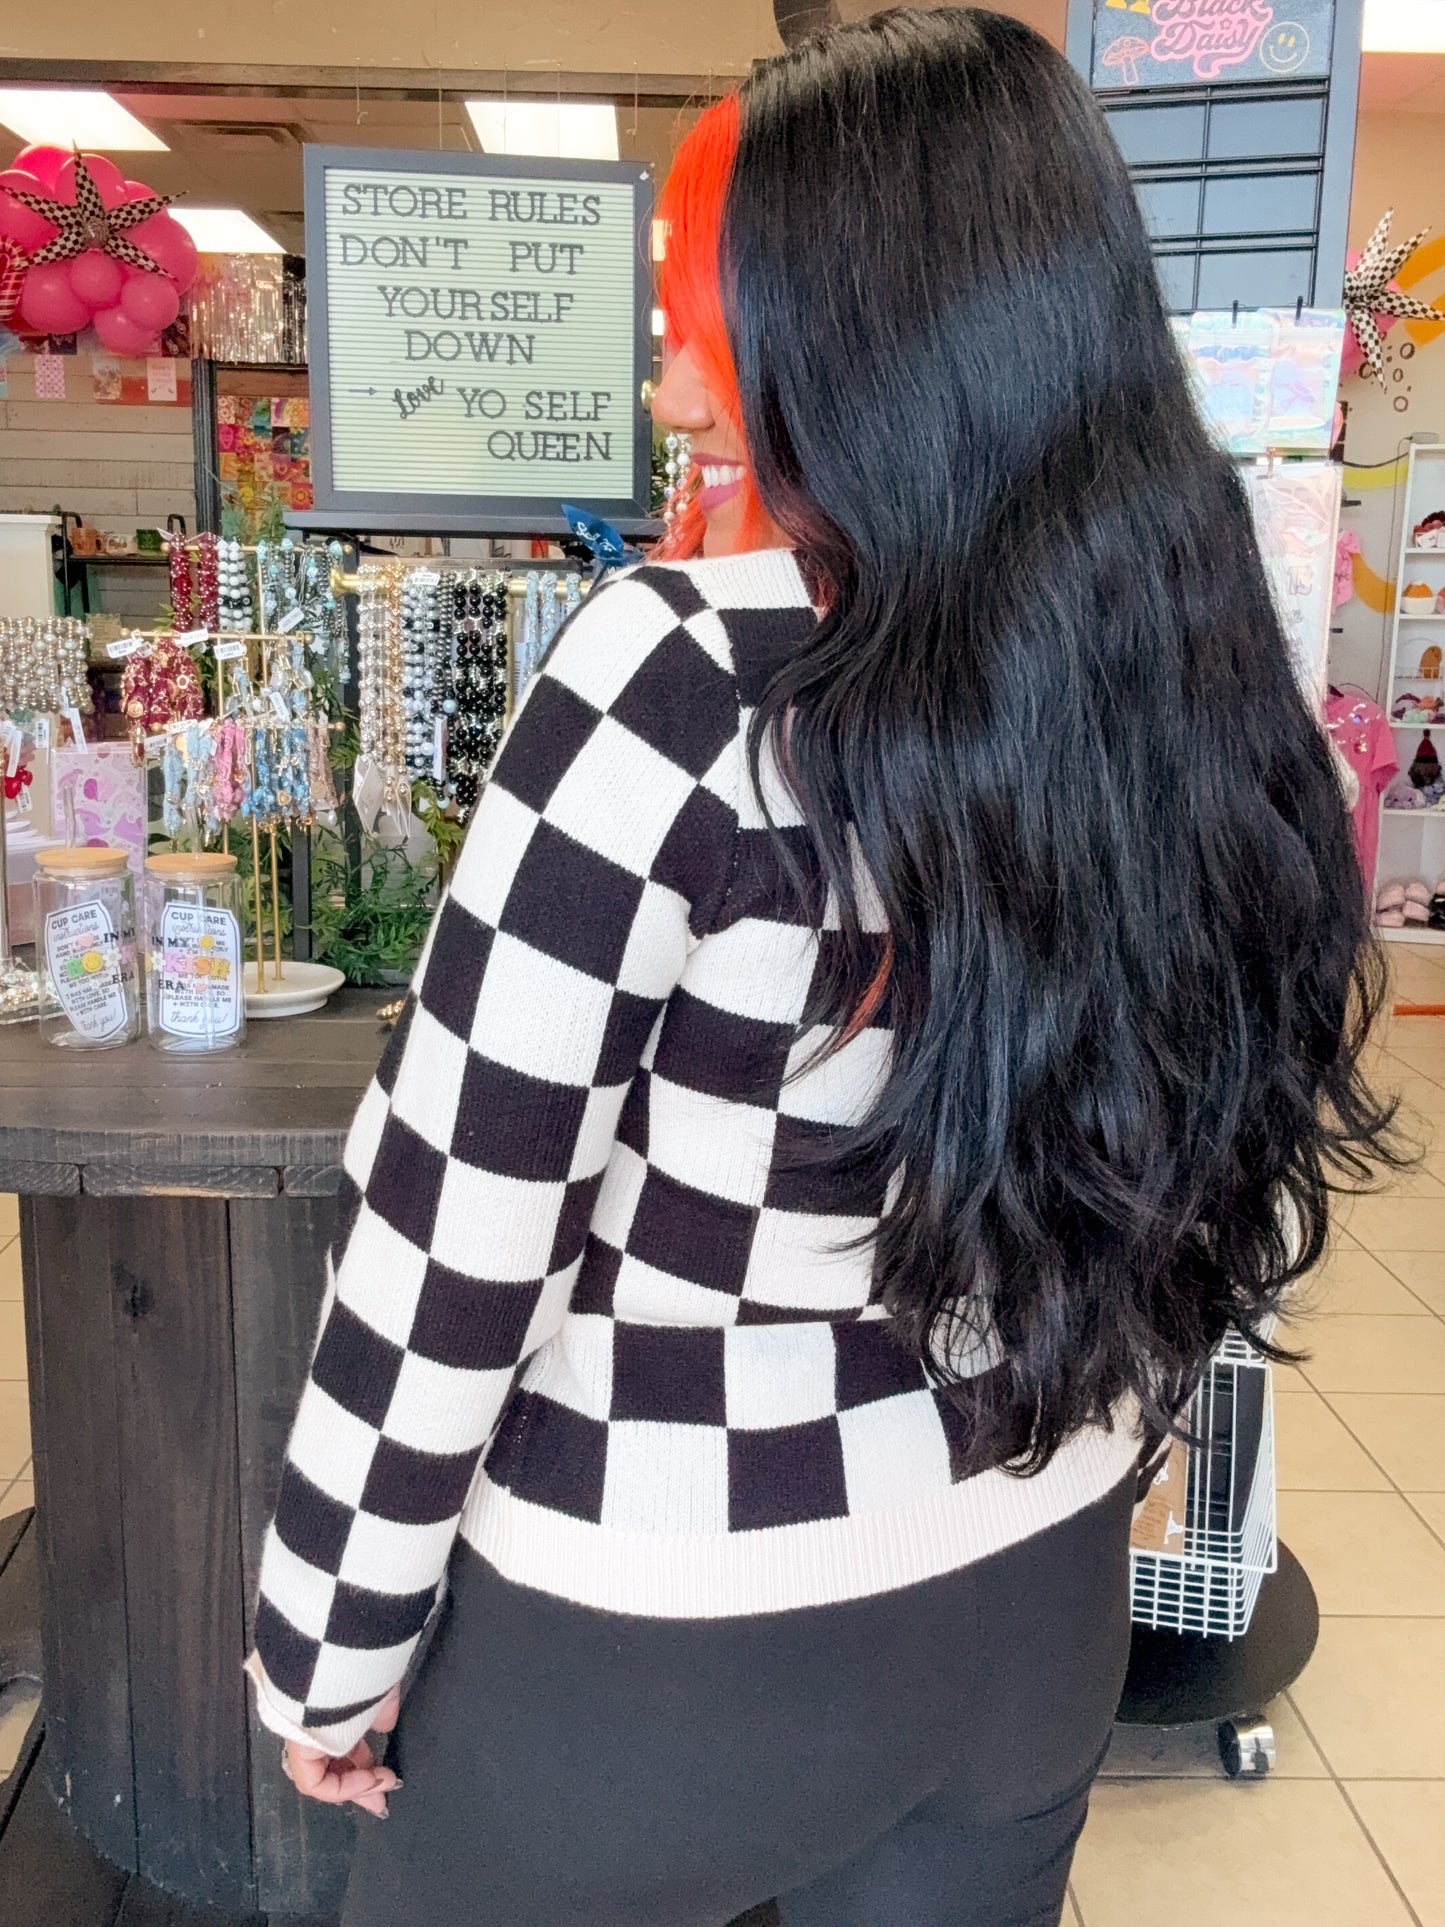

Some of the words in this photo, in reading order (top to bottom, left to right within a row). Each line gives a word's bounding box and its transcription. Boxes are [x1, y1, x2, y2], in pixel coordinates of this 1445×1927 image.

[1153, 18, 1260, 76] Daisy
[342, 184, 468, 219] STORE
[488, 189, 601, 226] RULES
[339, 234, 469, 270] DON'T
[508, 241, 584, 275] PUT
[377, 286, 574, 323] YOURSELF
[404, 330, 536, 365] DOWN
[457, 387, 507, 419] YO
[524, 390, 611, 422] SELF
[487, 430, 612, 462] QUEEN
[51, 917, 69, 930] CUP
[71, 909, 98, 924] CARE
[171, 911, 194, 921] CUP
[104, 931, 119, 943] IN
[151, 936, 164, 946] IN
[167, 937, 188, 948] MY
[112, 970, 135, 984] ERA
[158, 980, 185, 990] ERA
